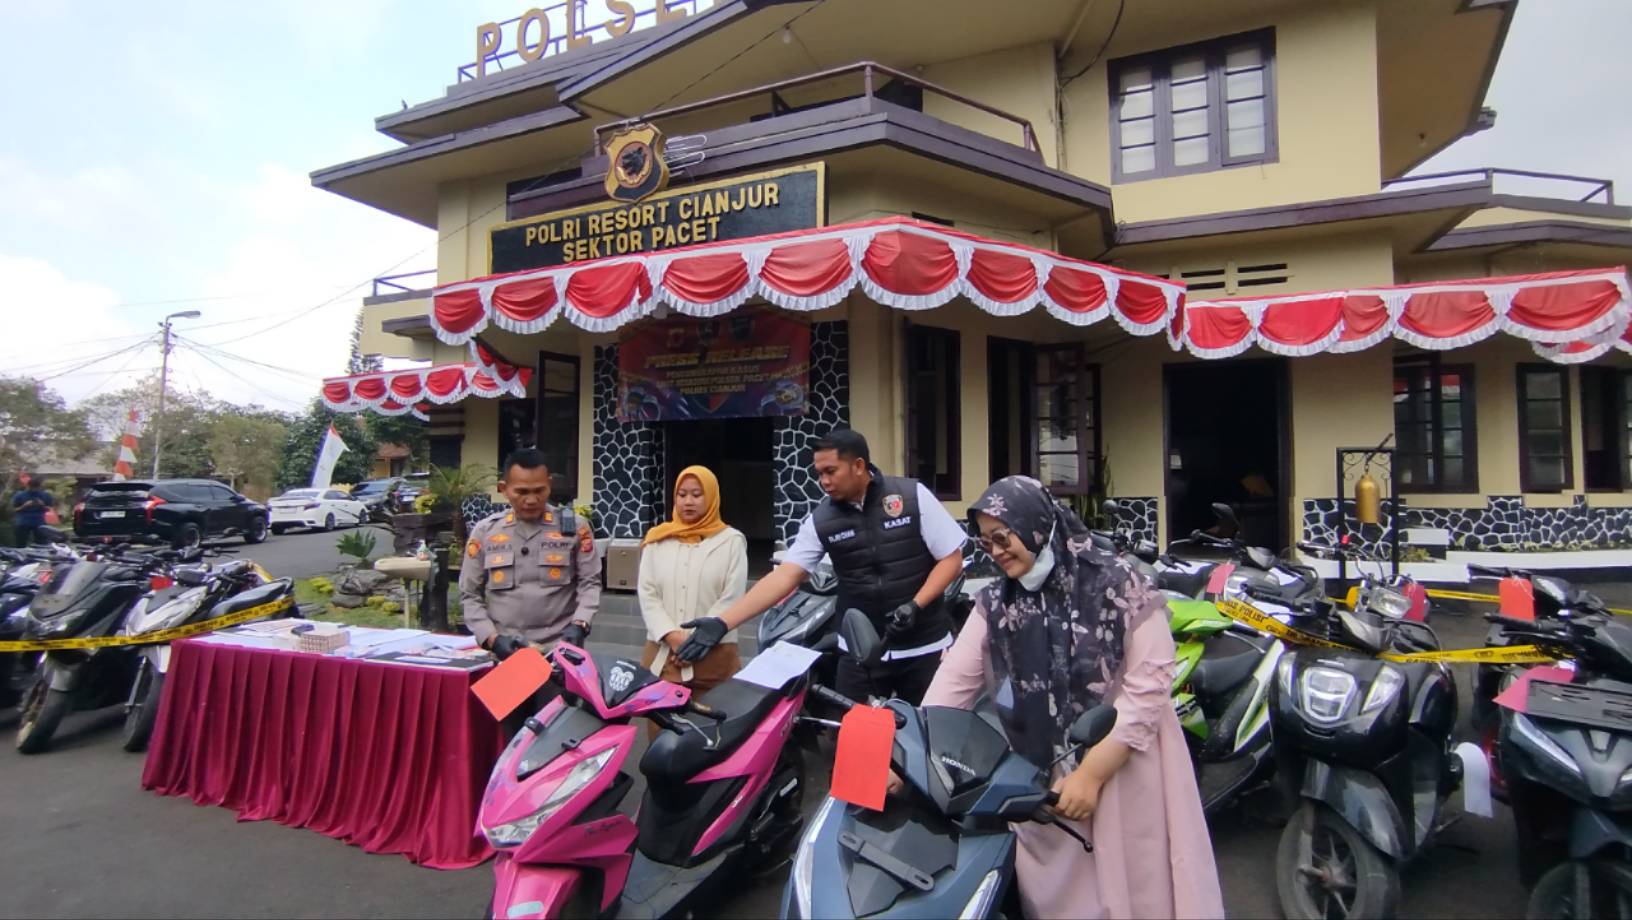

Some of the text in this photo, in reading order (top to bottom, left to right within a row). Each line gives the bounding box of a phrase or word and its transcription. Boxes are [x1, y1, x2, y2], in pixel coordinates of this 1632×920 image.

[526, 183, 779, 246] POLRI RESORT CIANJUR
[563, 217, 721, 262] SEKTOR PACET
[644, 346, 790, 368] PRESS RELEASE
[883, 516, 911, 529] KASAT
[541, 541, 569, 550] POLRI
[942, 756, 976, 777] HONDA
